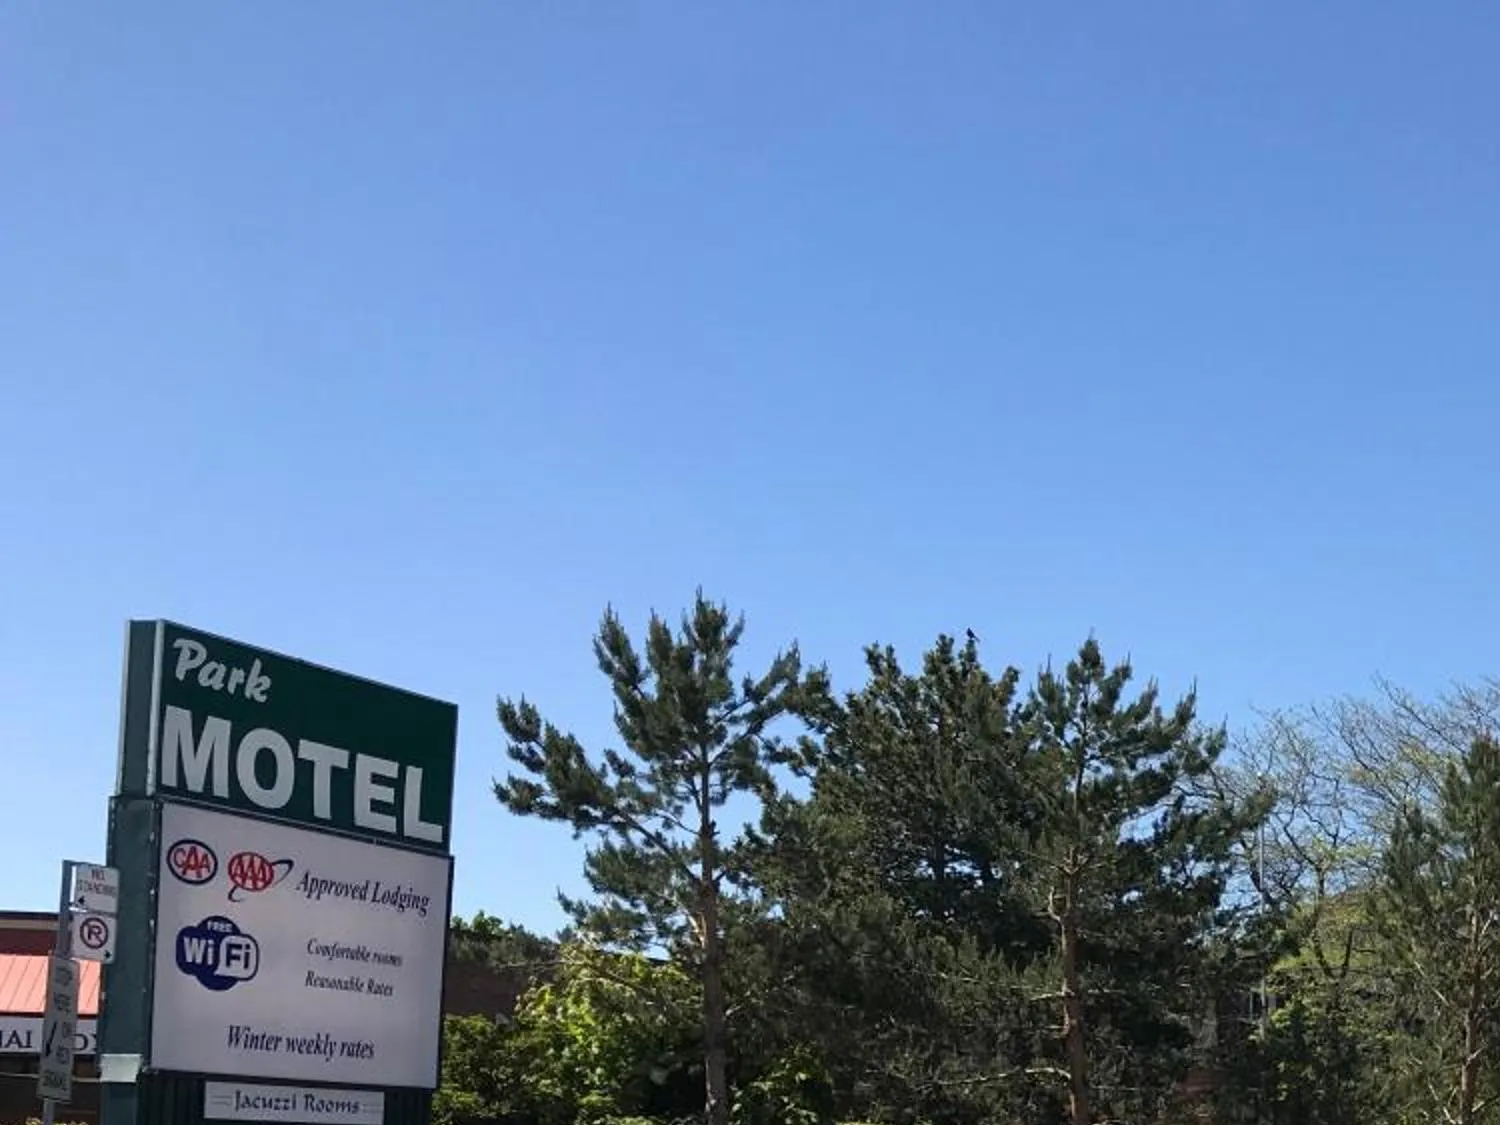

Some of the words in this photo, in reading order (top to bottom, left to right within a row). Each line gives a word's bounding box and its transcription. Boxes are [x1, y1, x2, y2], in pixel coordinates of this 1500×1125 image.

[174, 638, 272, 703] Park
[161, 705, 445, 843] MOTEL
[173, 846, 211, 879] CAA
[231, 854, 269, 890] AAA
[296, 871, 371, 901] Approved
[371, 881, 431, 917] Lodging
[207, 921, 233, 933] FREE
[307, 938, 371, 963] Comfortable
[372, 952, 403, 967] rooms
[305, 970, 365, 993] Reasonable
[366, 978, 394, 997] Rates
[227, 1025, 283, 1052] Winter
[286, 1032, 337, 1062] weekly
[340, 1039, 375, 1060] rates
[235, 1089, 297, 1112] Jacuzzi
[304, 1093, 361, 1115] Rooms
